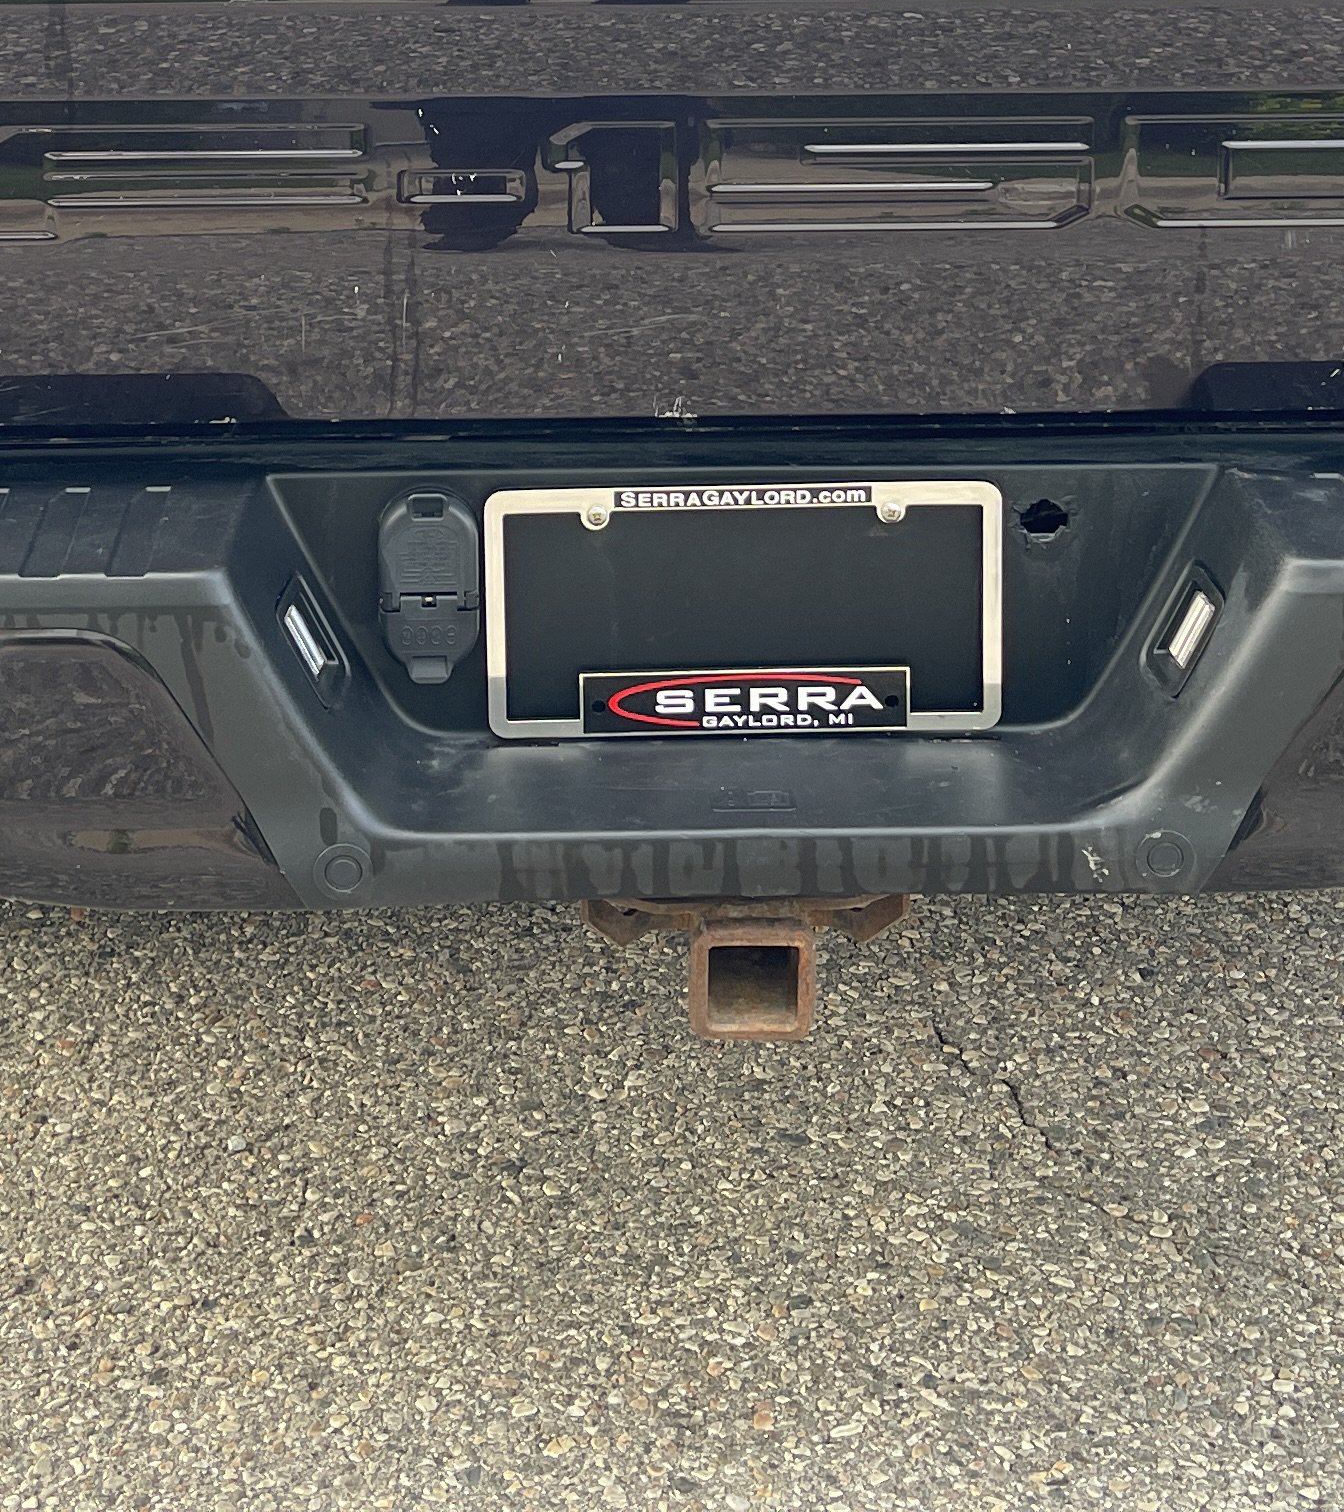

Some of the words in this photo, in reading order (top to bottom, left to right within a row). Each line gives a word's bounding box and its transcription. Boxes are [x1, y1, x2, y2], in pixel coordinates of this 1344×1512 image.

[620, 488, 866, 507] SERRAGAYLORD.com
[654, 685, 884, 714] SERRA
[702, 714, 819, 728] GAYLORD,
[828, 713, 854, 725] MI
